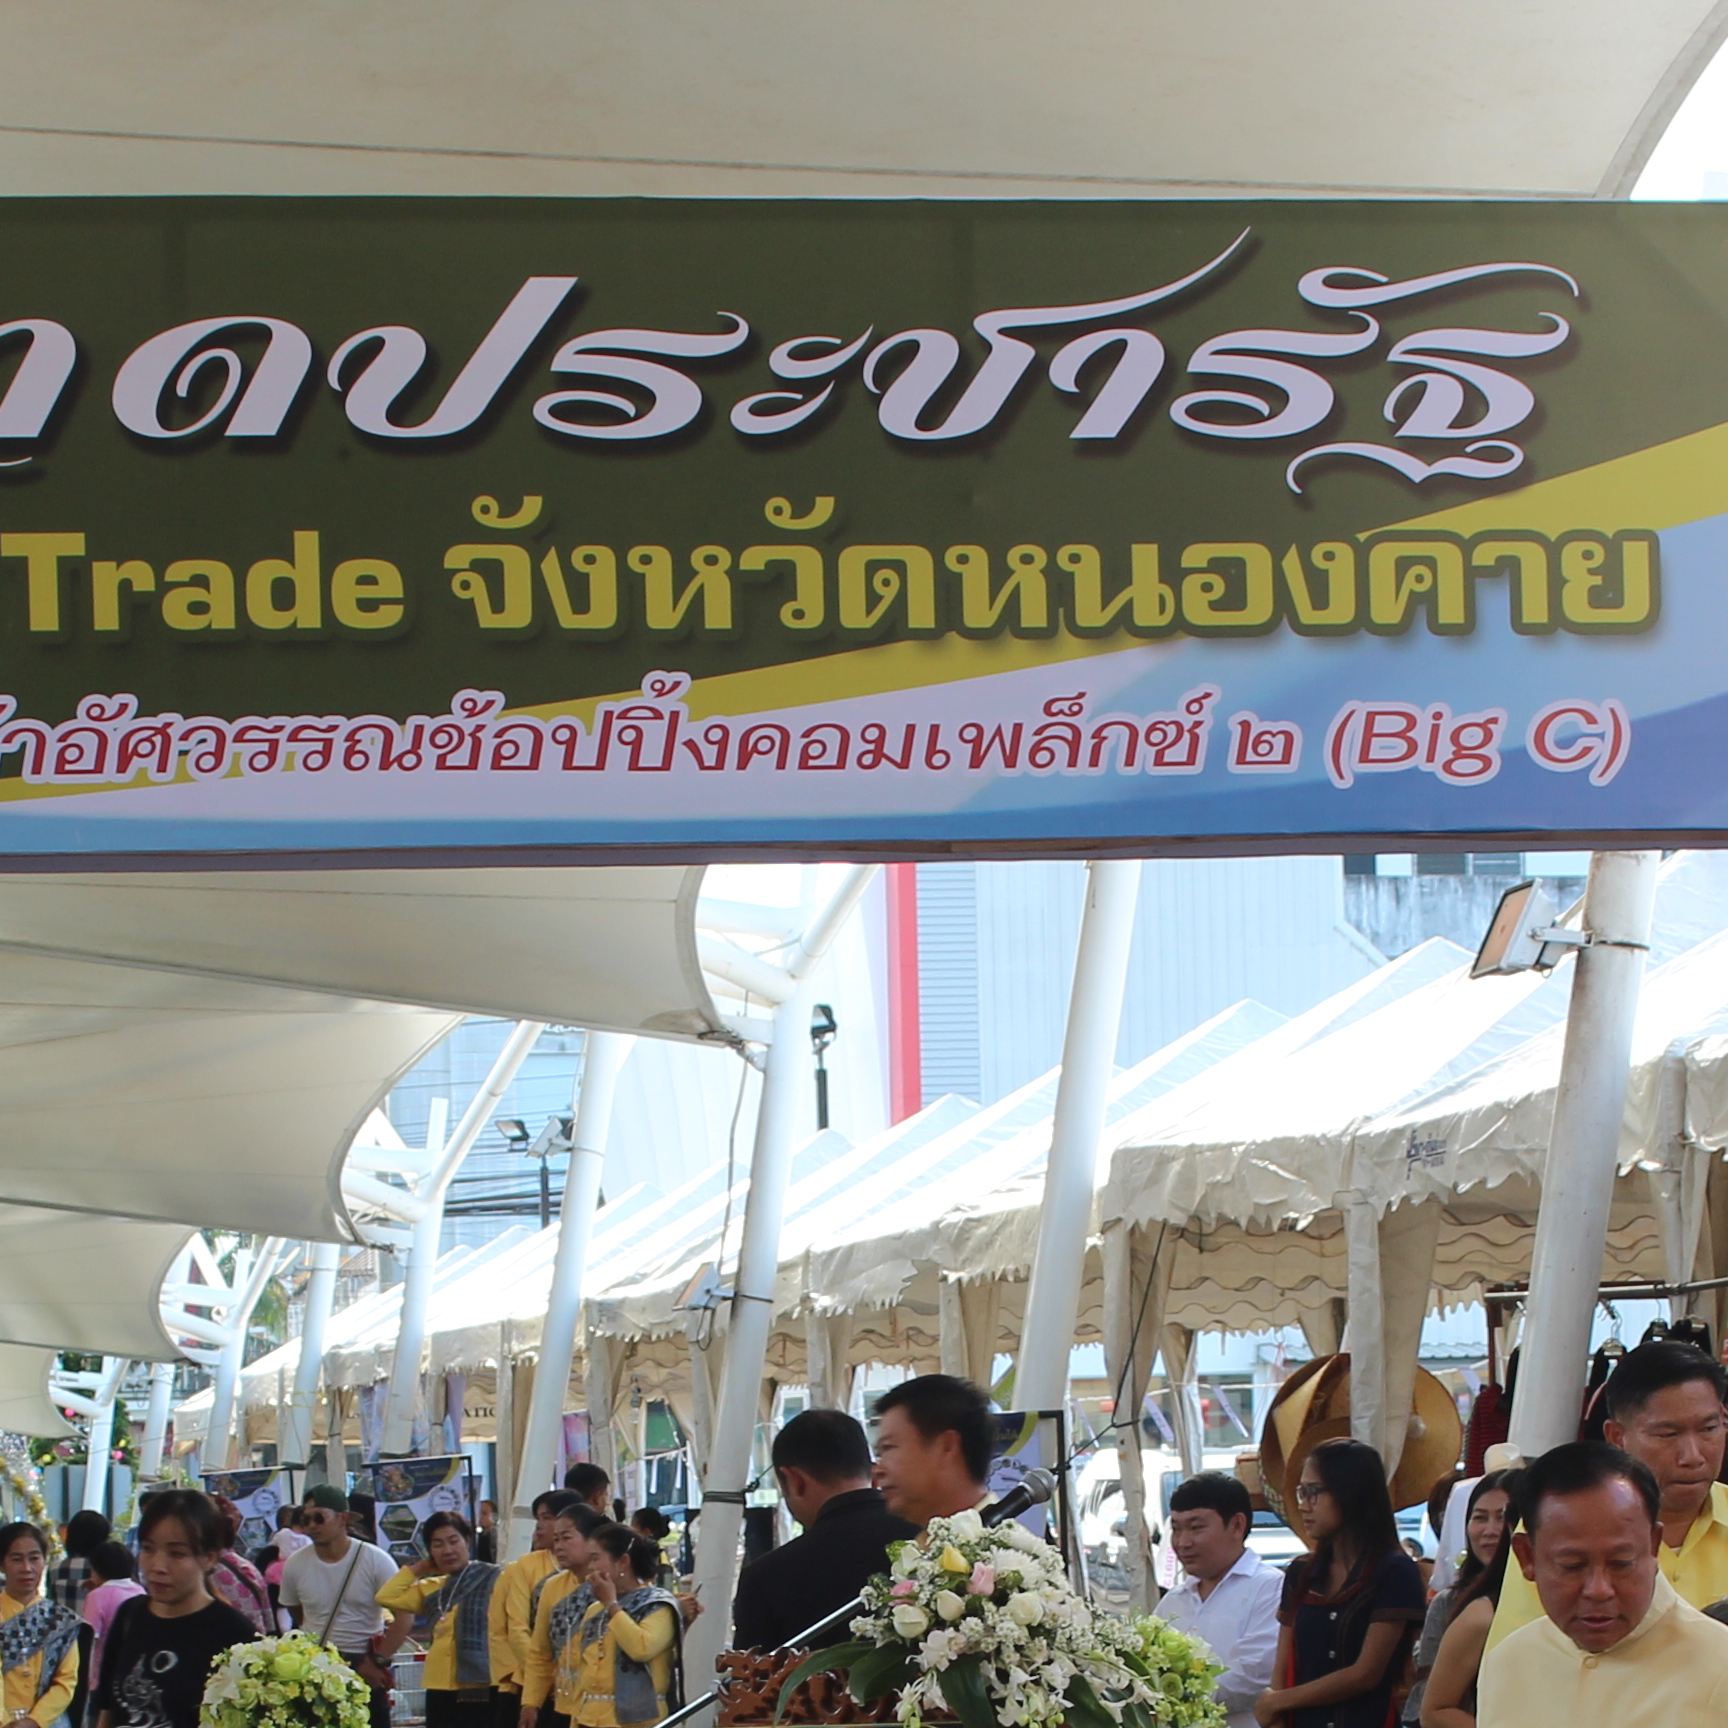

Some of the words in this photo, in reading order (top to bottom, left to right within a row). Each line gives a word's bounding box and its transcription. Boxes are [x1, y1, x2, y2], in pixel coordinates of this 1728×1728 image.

[443, 494, 1651, 633] จังหวัดหนองคาย
[1229, 714, 1297, 770] ๒
[1329, 706, 1498, 783] (Big
[1529, 704, 1627, 780] C)
